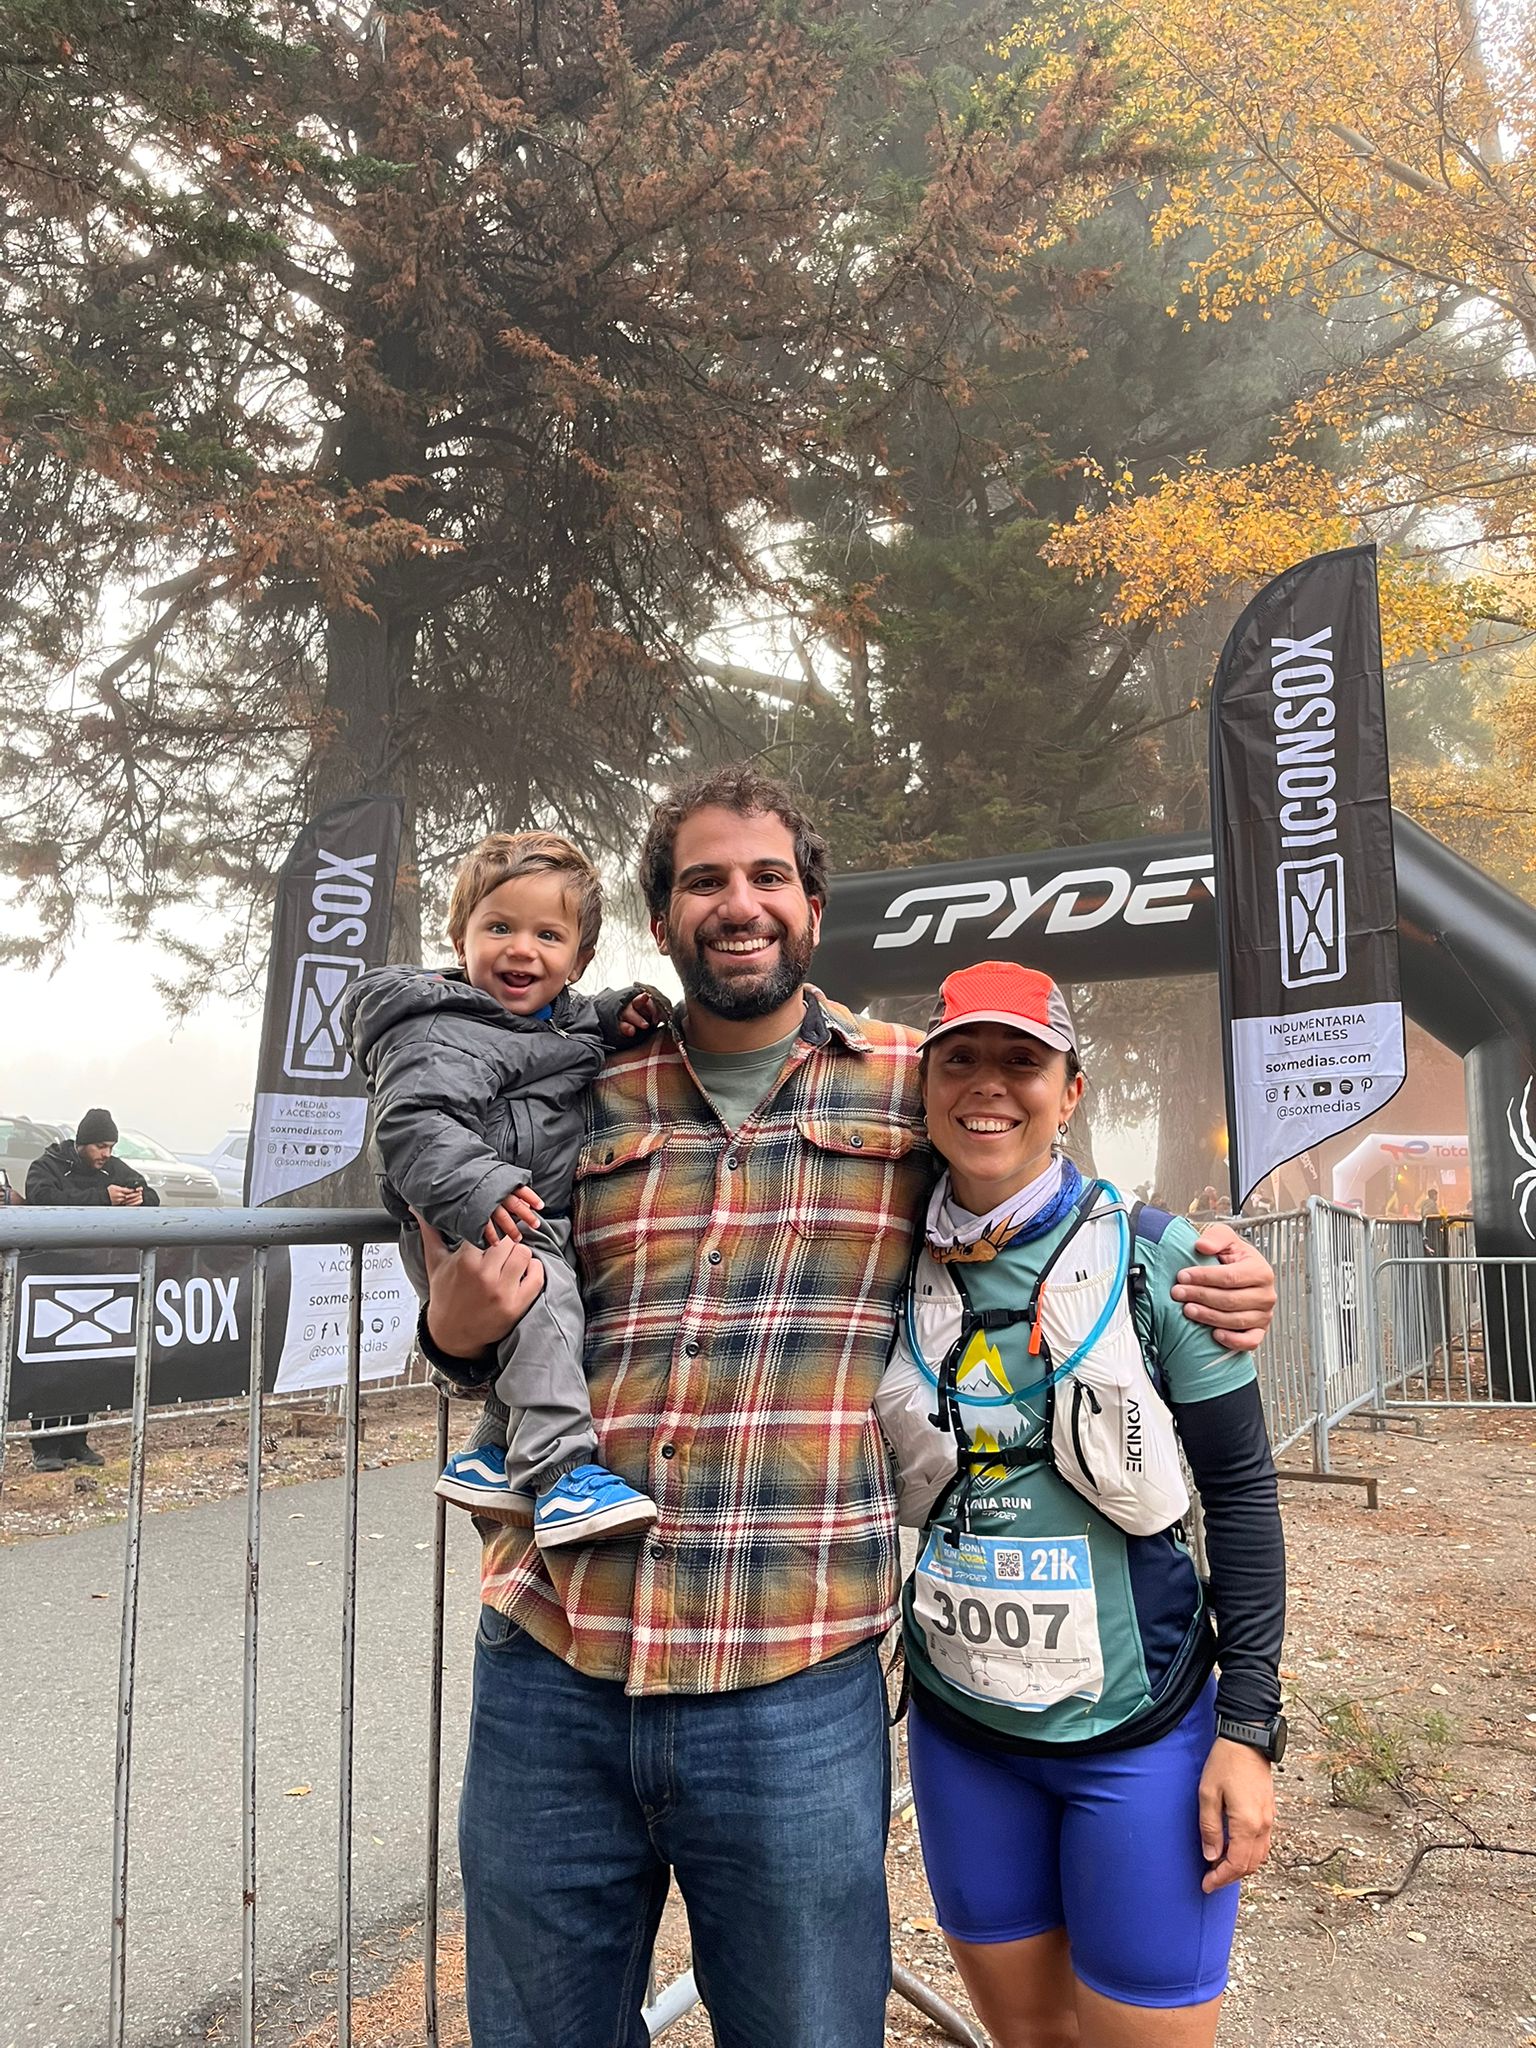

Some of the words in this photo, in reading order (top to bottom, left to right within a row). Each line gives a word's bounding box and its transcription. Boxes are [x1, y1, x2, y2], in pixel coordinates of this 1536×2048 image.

[1271, 626, 1337, 848] ICONSOX
[308, 848, 377, 947] SOX
[873, 853, 1215, 949] SPYDE
[1269, 1013, 1366, 1035] INDUMENTARIA
[1284, 1029, 1349, 1046] SEAMLESS
[1265, 1052, 1372, 1073] soxmedias.com
[295, 1100, 328, 1109] MEDIAS
[1276, 1100, 1361, 1120] @soxmedias
[286, 1109, 342, 1119] ACCESORIOS
[270, 1126, 343, 1136] soxmedias.com
[1432, 1144, 1469, 1158] Tota
[274, 1157, 332, 1168] @soxmedias
[340, 1245, 380, 1257] MIAS
[318, 1261, 326, 1272] Y
[155, 1277, 240, 1347] SOX
[1001, 1497, 1032, 1510] RUN
[981, 1509, 1017, 1521] SPYDER
[1030, 1547, 1078, 1582] 21k
[930, 1590, 1070, 1650] 3007
